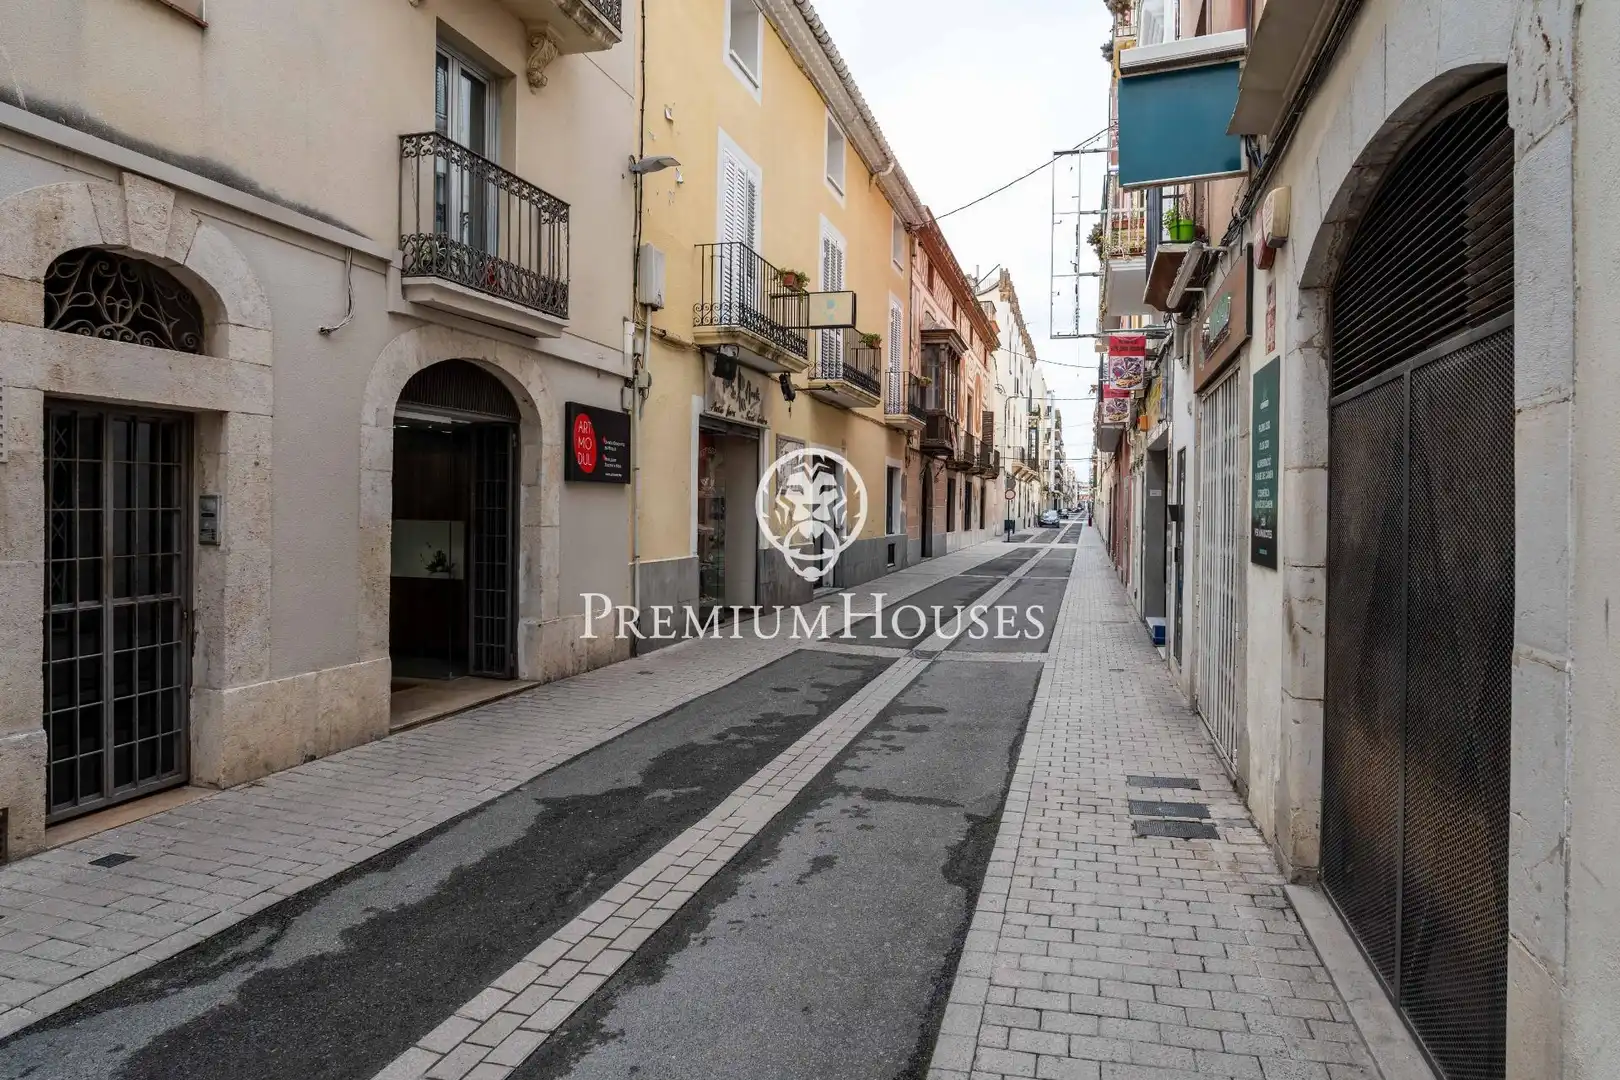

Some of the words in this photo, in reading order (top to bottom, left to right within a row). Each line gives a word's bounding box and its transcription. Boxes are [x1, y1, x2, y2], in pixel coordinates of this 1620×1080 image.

[578, 420, 592, 434] ART
[578, 437, 593, 451] MO
[577, 452, 592, 466] DUL
